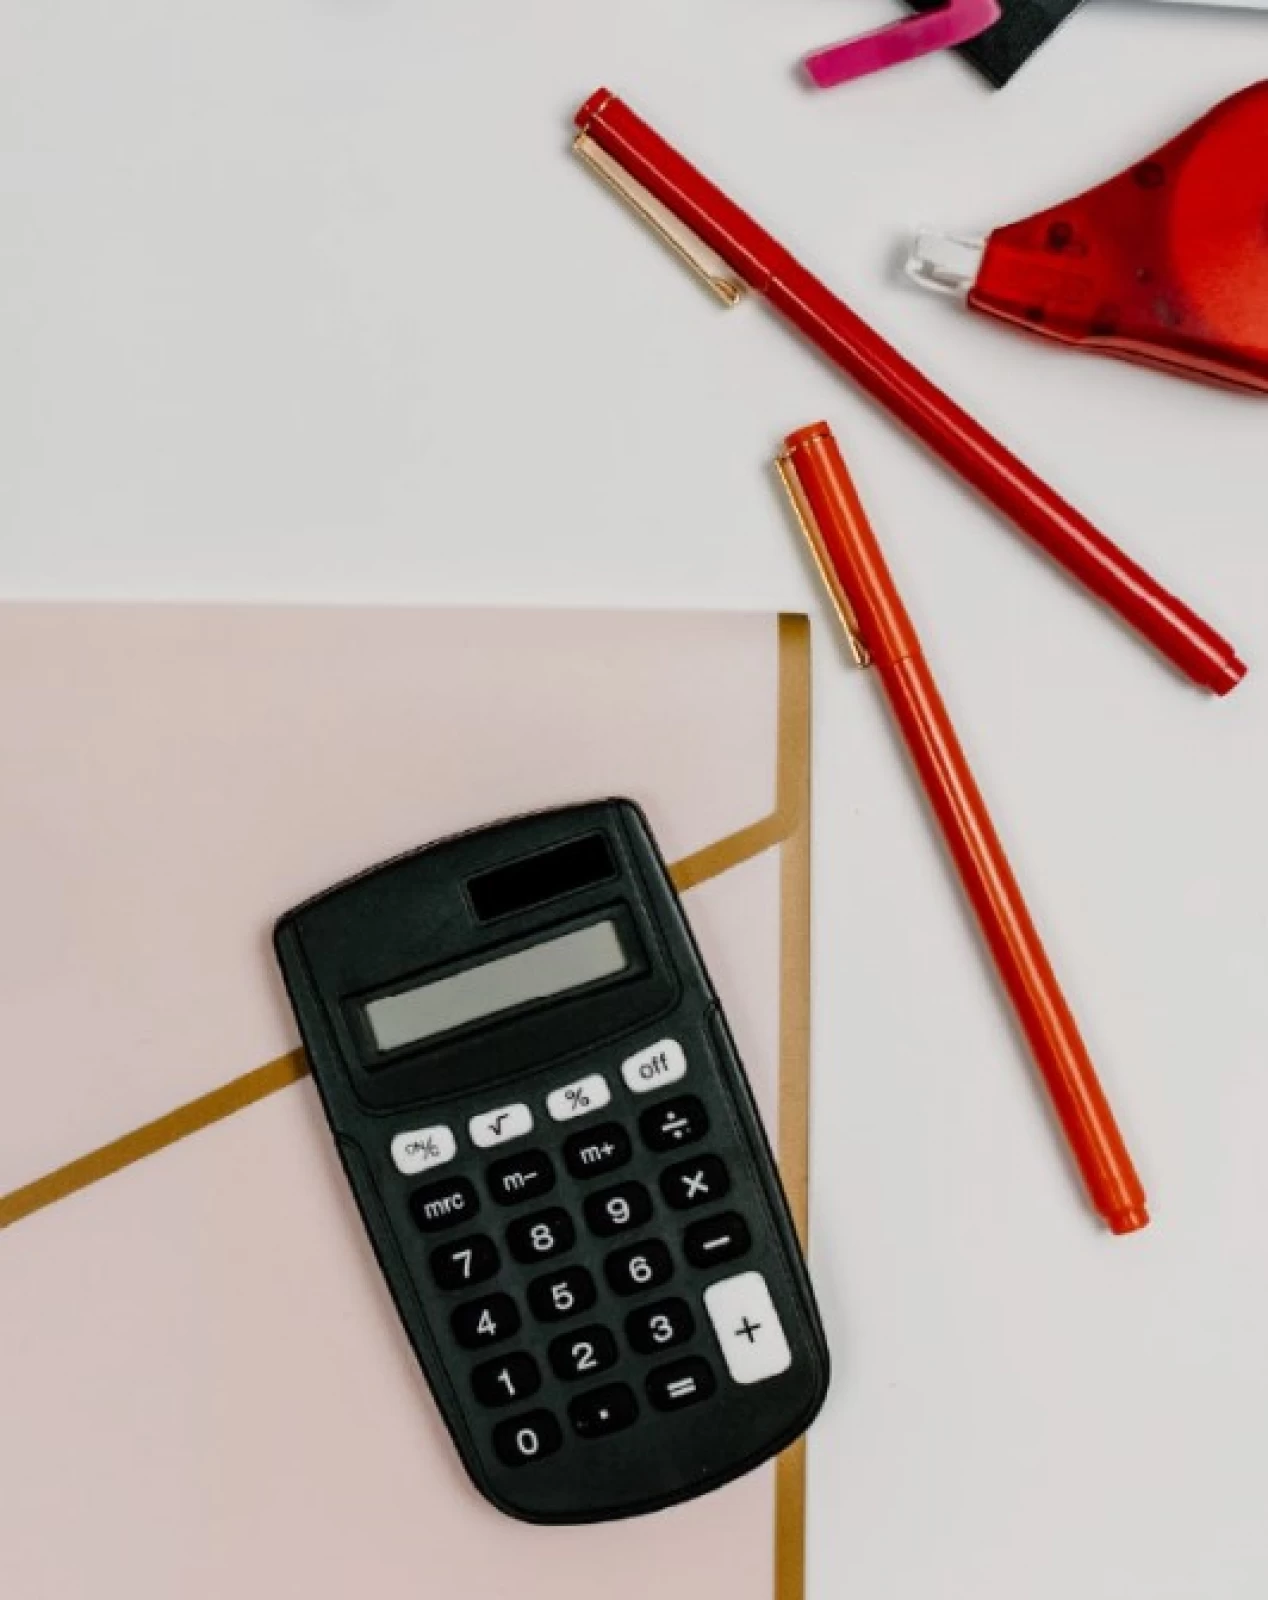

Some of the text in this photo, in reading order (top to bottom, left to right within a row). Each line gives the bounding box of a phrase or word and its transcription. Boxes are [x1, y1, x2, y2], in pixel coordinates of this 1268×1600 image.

[638, 1051, 670, 1079] off
[564, 1087, 591, 1110] %
[580, 1141, 616, 1165] m+
[424, 1194, 464, 1218] mrc
[607, 1198, 630, 1224] 9
[531, 1224, 554, 1251] 8
[452, 1249, 471, 1277] 7
[628, 1256, 652, 1282] 6
[552, 1282, 573, 1310] 5
[478, 1309, 498, 1334] 4
[650, 1315, 673, 1343] 3
[735, 1315, 761, 1344] +
[571, 1342, 597, 1370] 2
[497, 1370, 516, 1396] 1
[667, 1377, 697, 1398] =
[516, 1429, 538, 1455] 0
